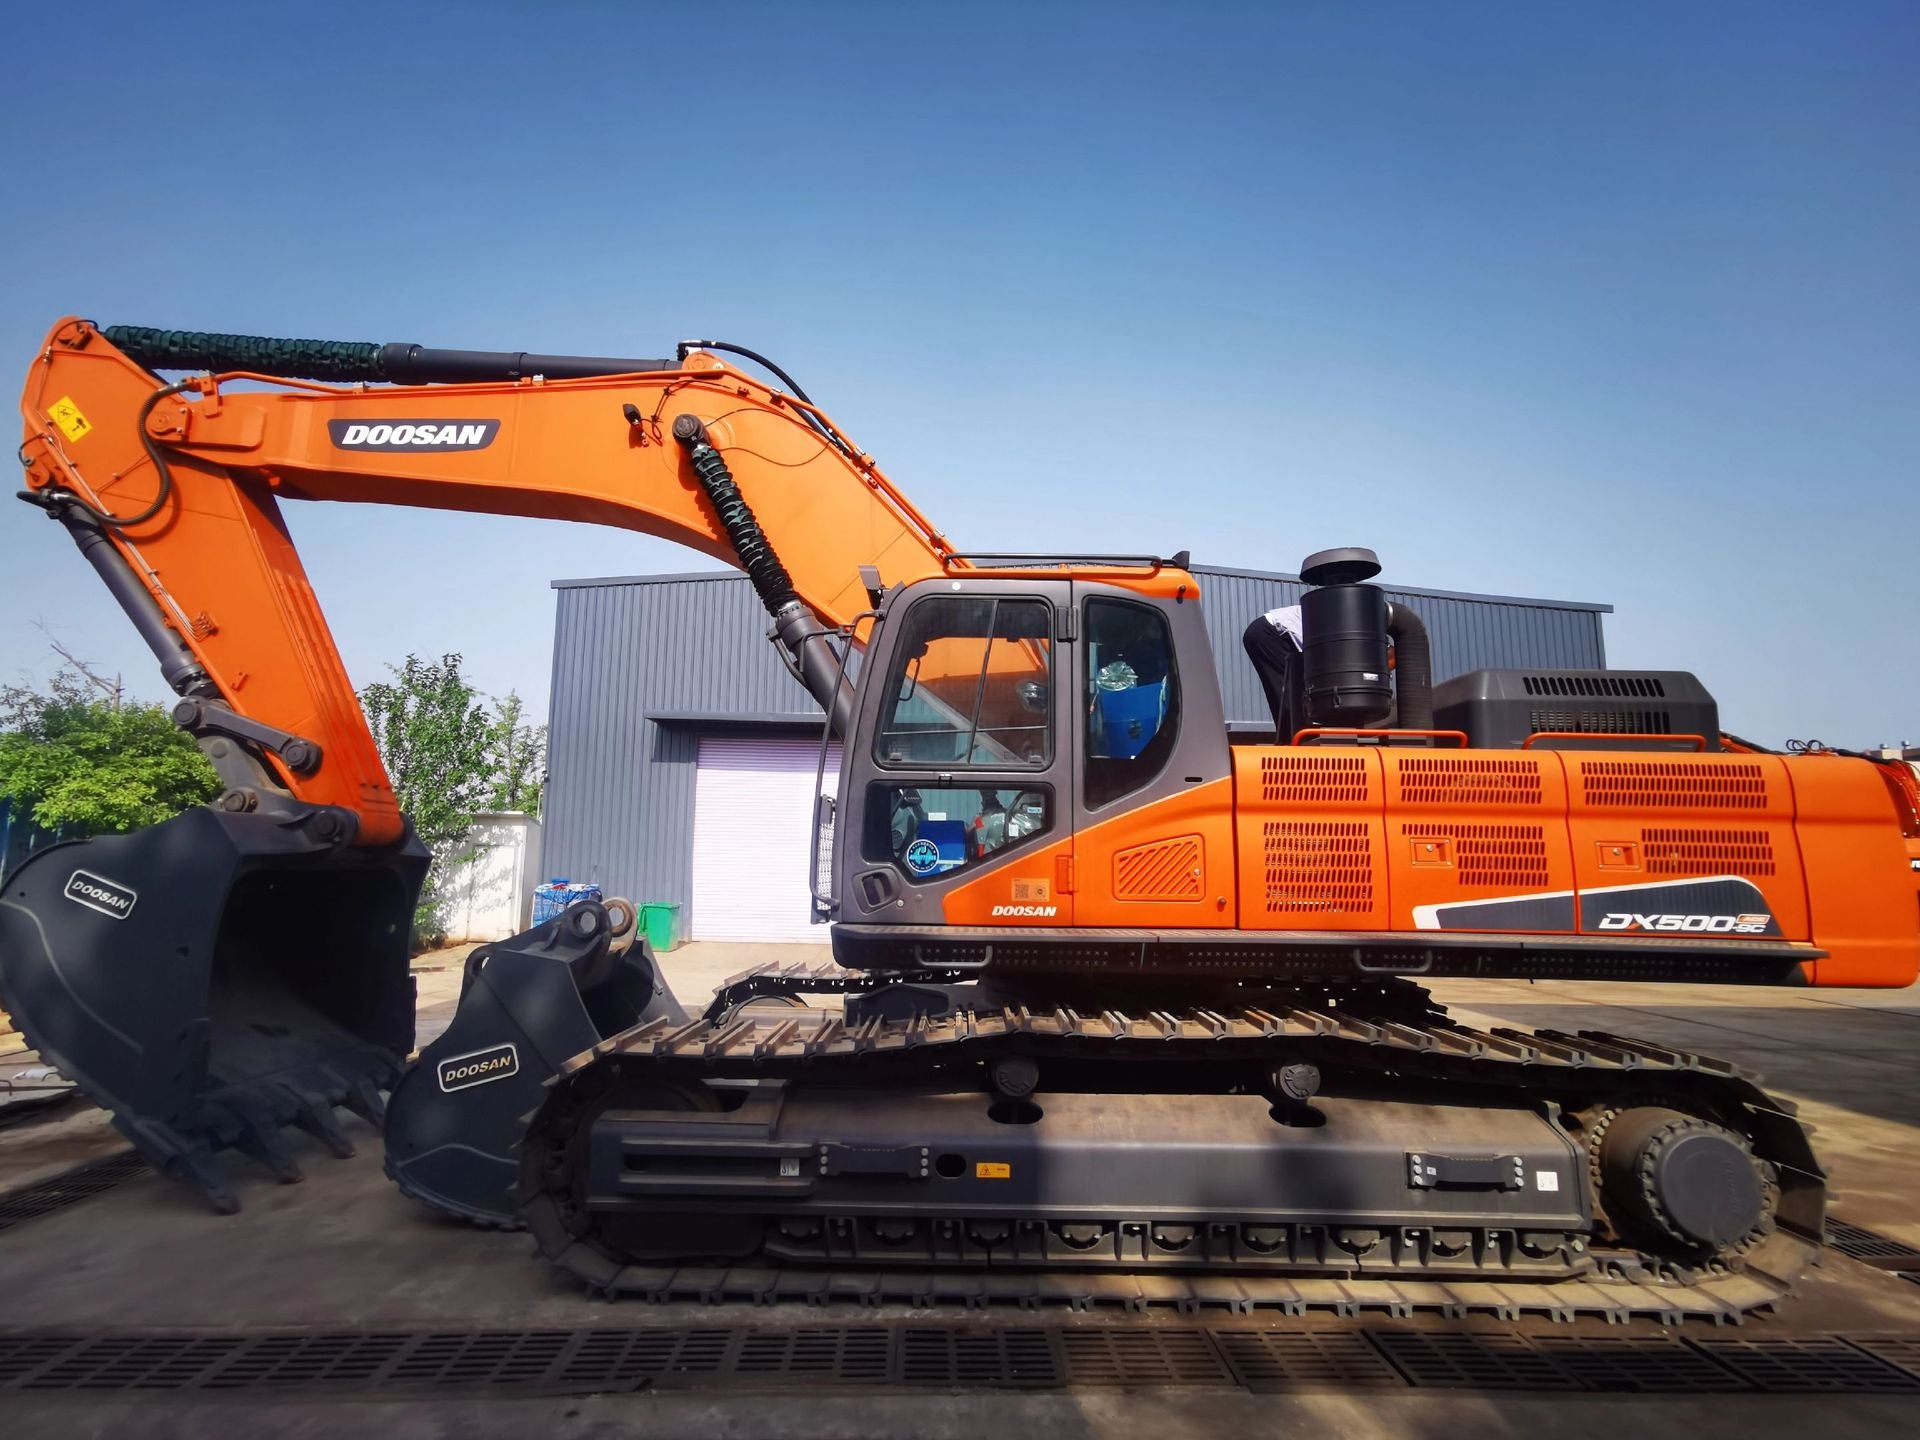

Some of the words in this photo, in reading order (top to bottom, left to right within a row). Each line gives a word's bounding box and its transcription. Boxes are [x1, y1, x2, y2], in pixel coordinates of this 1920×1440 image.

[341, 424, 487, 446] DOOSAN
[71, 881, 130, 910] DOOSAN
[991, 905, 1057, 917] DOOSAN
[445, 1055, 511, 1082] DOOSAN
